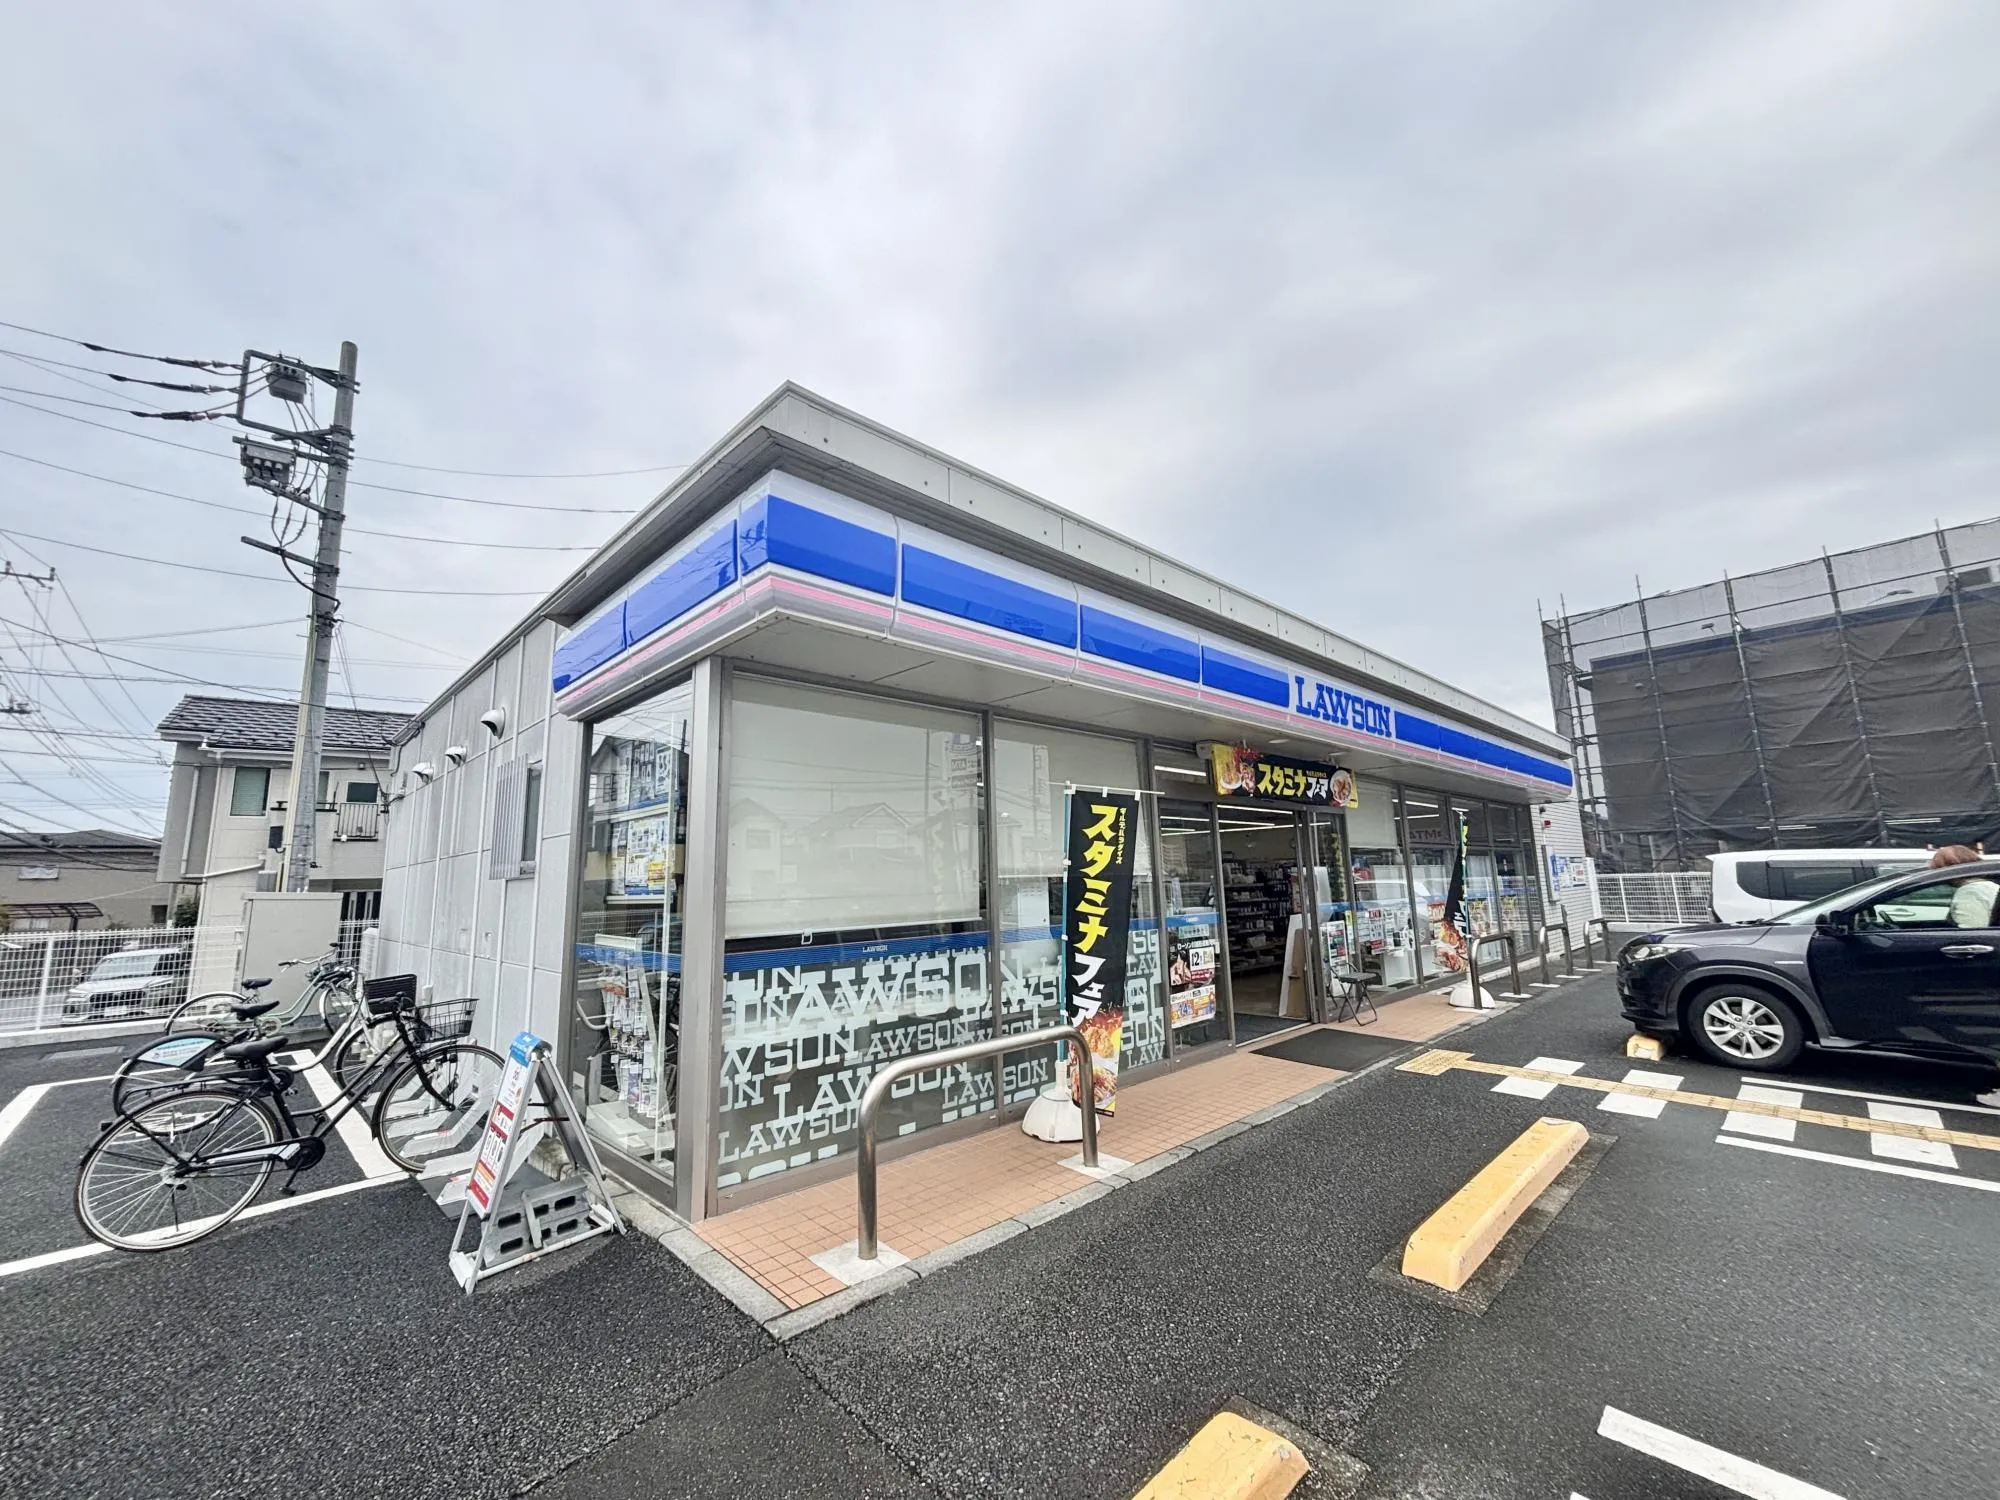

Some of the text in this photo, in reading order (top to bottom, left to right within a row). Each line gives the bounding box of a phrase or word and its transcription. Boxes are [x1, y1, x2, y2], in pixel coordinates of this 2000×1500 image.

[1295, 675, 1392, 738] LAWSON
[1257, 763, 1329, 799] スタミナフェア
[1071, 804, 1119, 1028] スタミナフェア
[1127, 1042, 1165, 1069] LAW
